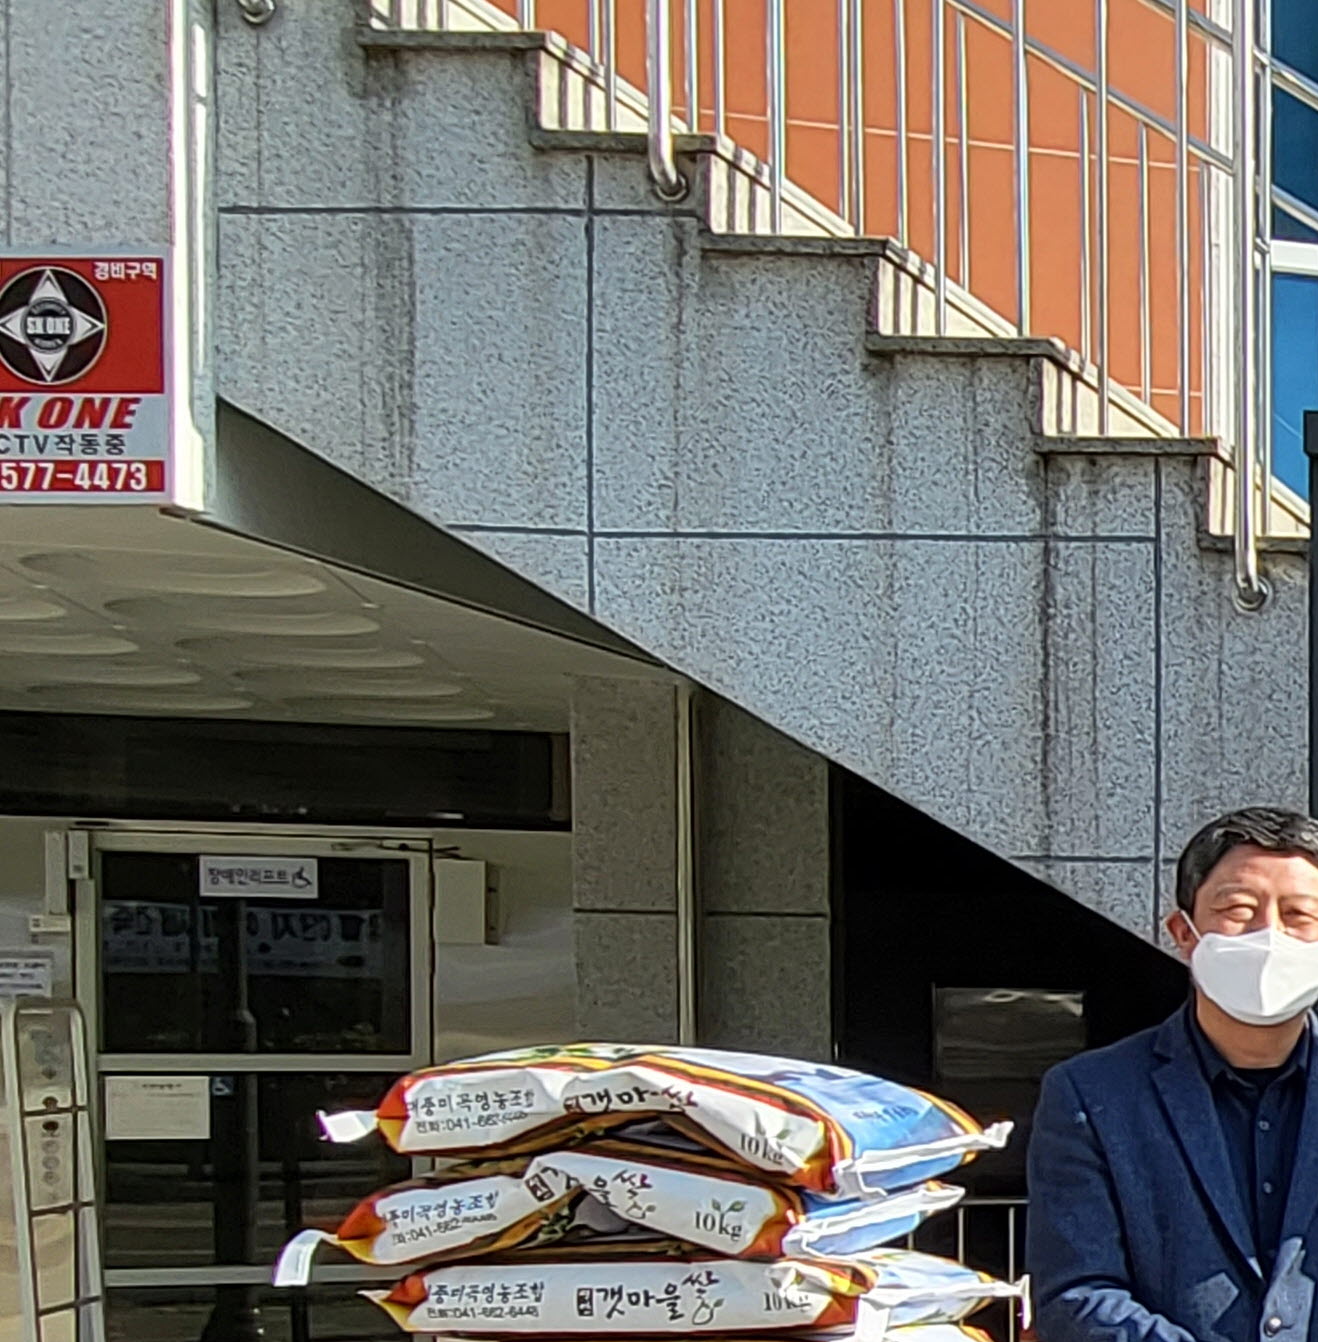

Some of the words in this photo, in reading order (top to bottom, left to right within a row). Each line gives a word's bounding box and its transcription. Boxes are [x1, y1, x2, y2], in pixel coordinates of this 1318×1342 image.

[94, 261, 157, 281] 경비구역
[37, 397, 141, 429] ONE
[207, 867, 290, 886] 장애인리프트
